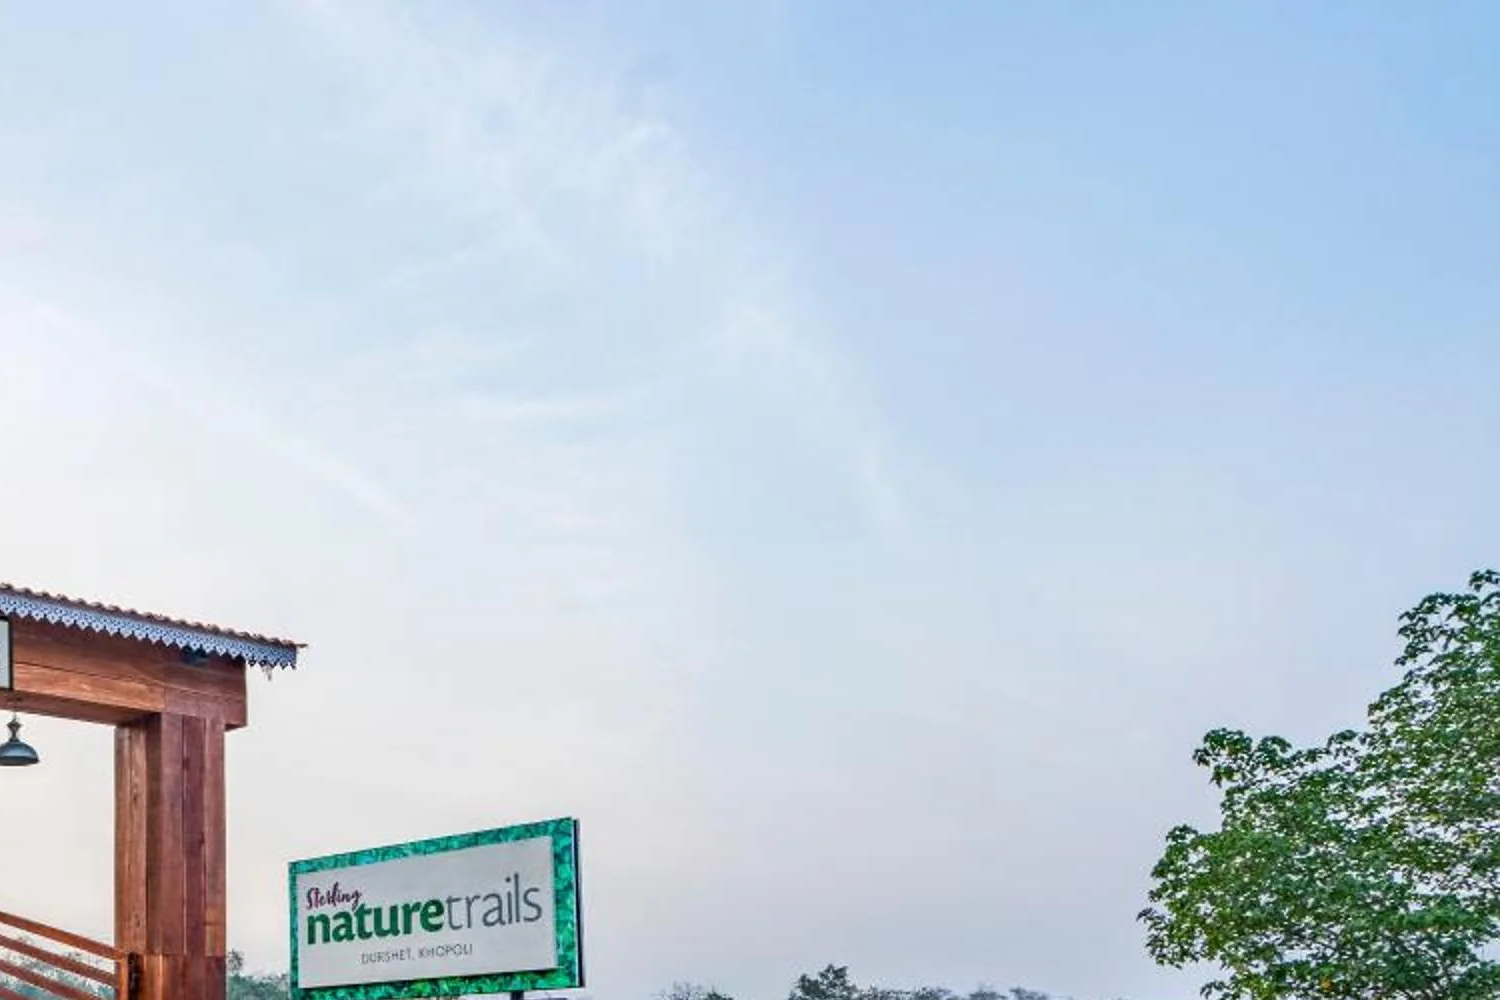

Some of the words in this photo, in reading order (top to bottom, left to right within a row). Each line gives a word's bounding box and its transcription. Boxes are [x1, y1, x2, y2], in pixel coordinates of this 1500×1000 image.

[306, 881, 362, 913] Sterling
[307, 872, 543, 944] naturetrails
[361, 947, 415, 965] DURSHET,
[419, 943, 473, 958] KHOPOLI
